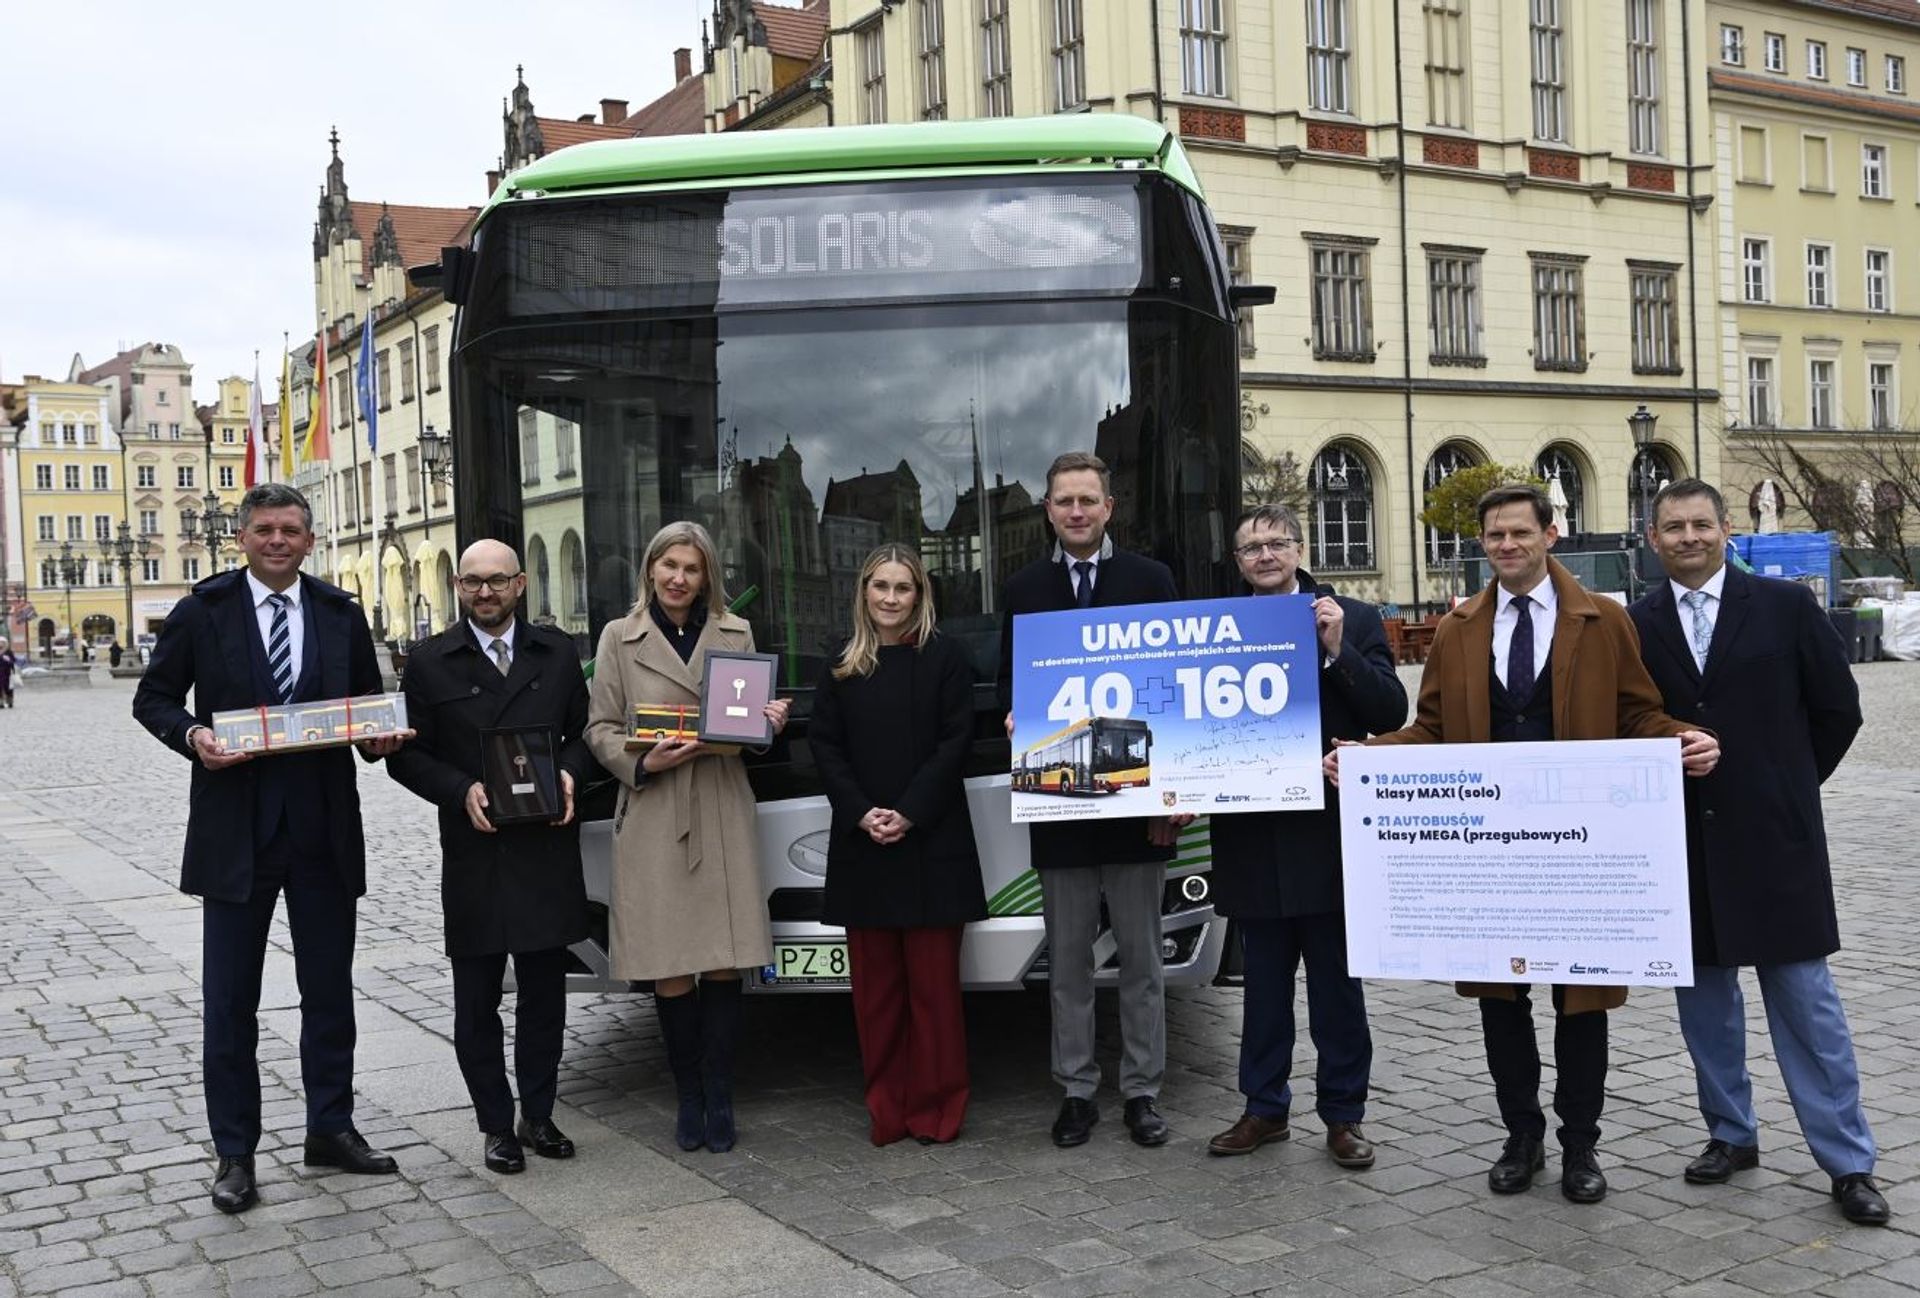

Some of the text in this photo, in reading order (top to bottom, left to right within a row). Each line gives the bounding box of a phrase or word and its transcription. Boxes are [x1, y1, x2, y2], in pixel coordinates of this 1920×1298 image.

[718, 210, 934, 276] SOLARIS
[1082, 615, 1242, 652] UMOWA
[1032, 641, 1296, 668] na dostawę nowych autobusów miejskich dla Wrocławia
[1375, 769, 1483, 785] 19 AUTOBUSÓW
[1231, 794, 1251, 803] MPK
[1376, 784, 1501, 802] klasy MAXI (solo)
[1377, 812, 1485, 827] 21 AUTOBUSÓW
[1378, 826, 1588, 844] klasy MEGA (przegubowych)
[781, 948, 818, 975] PZ
[1587, 966, 1609, 975] MPK
